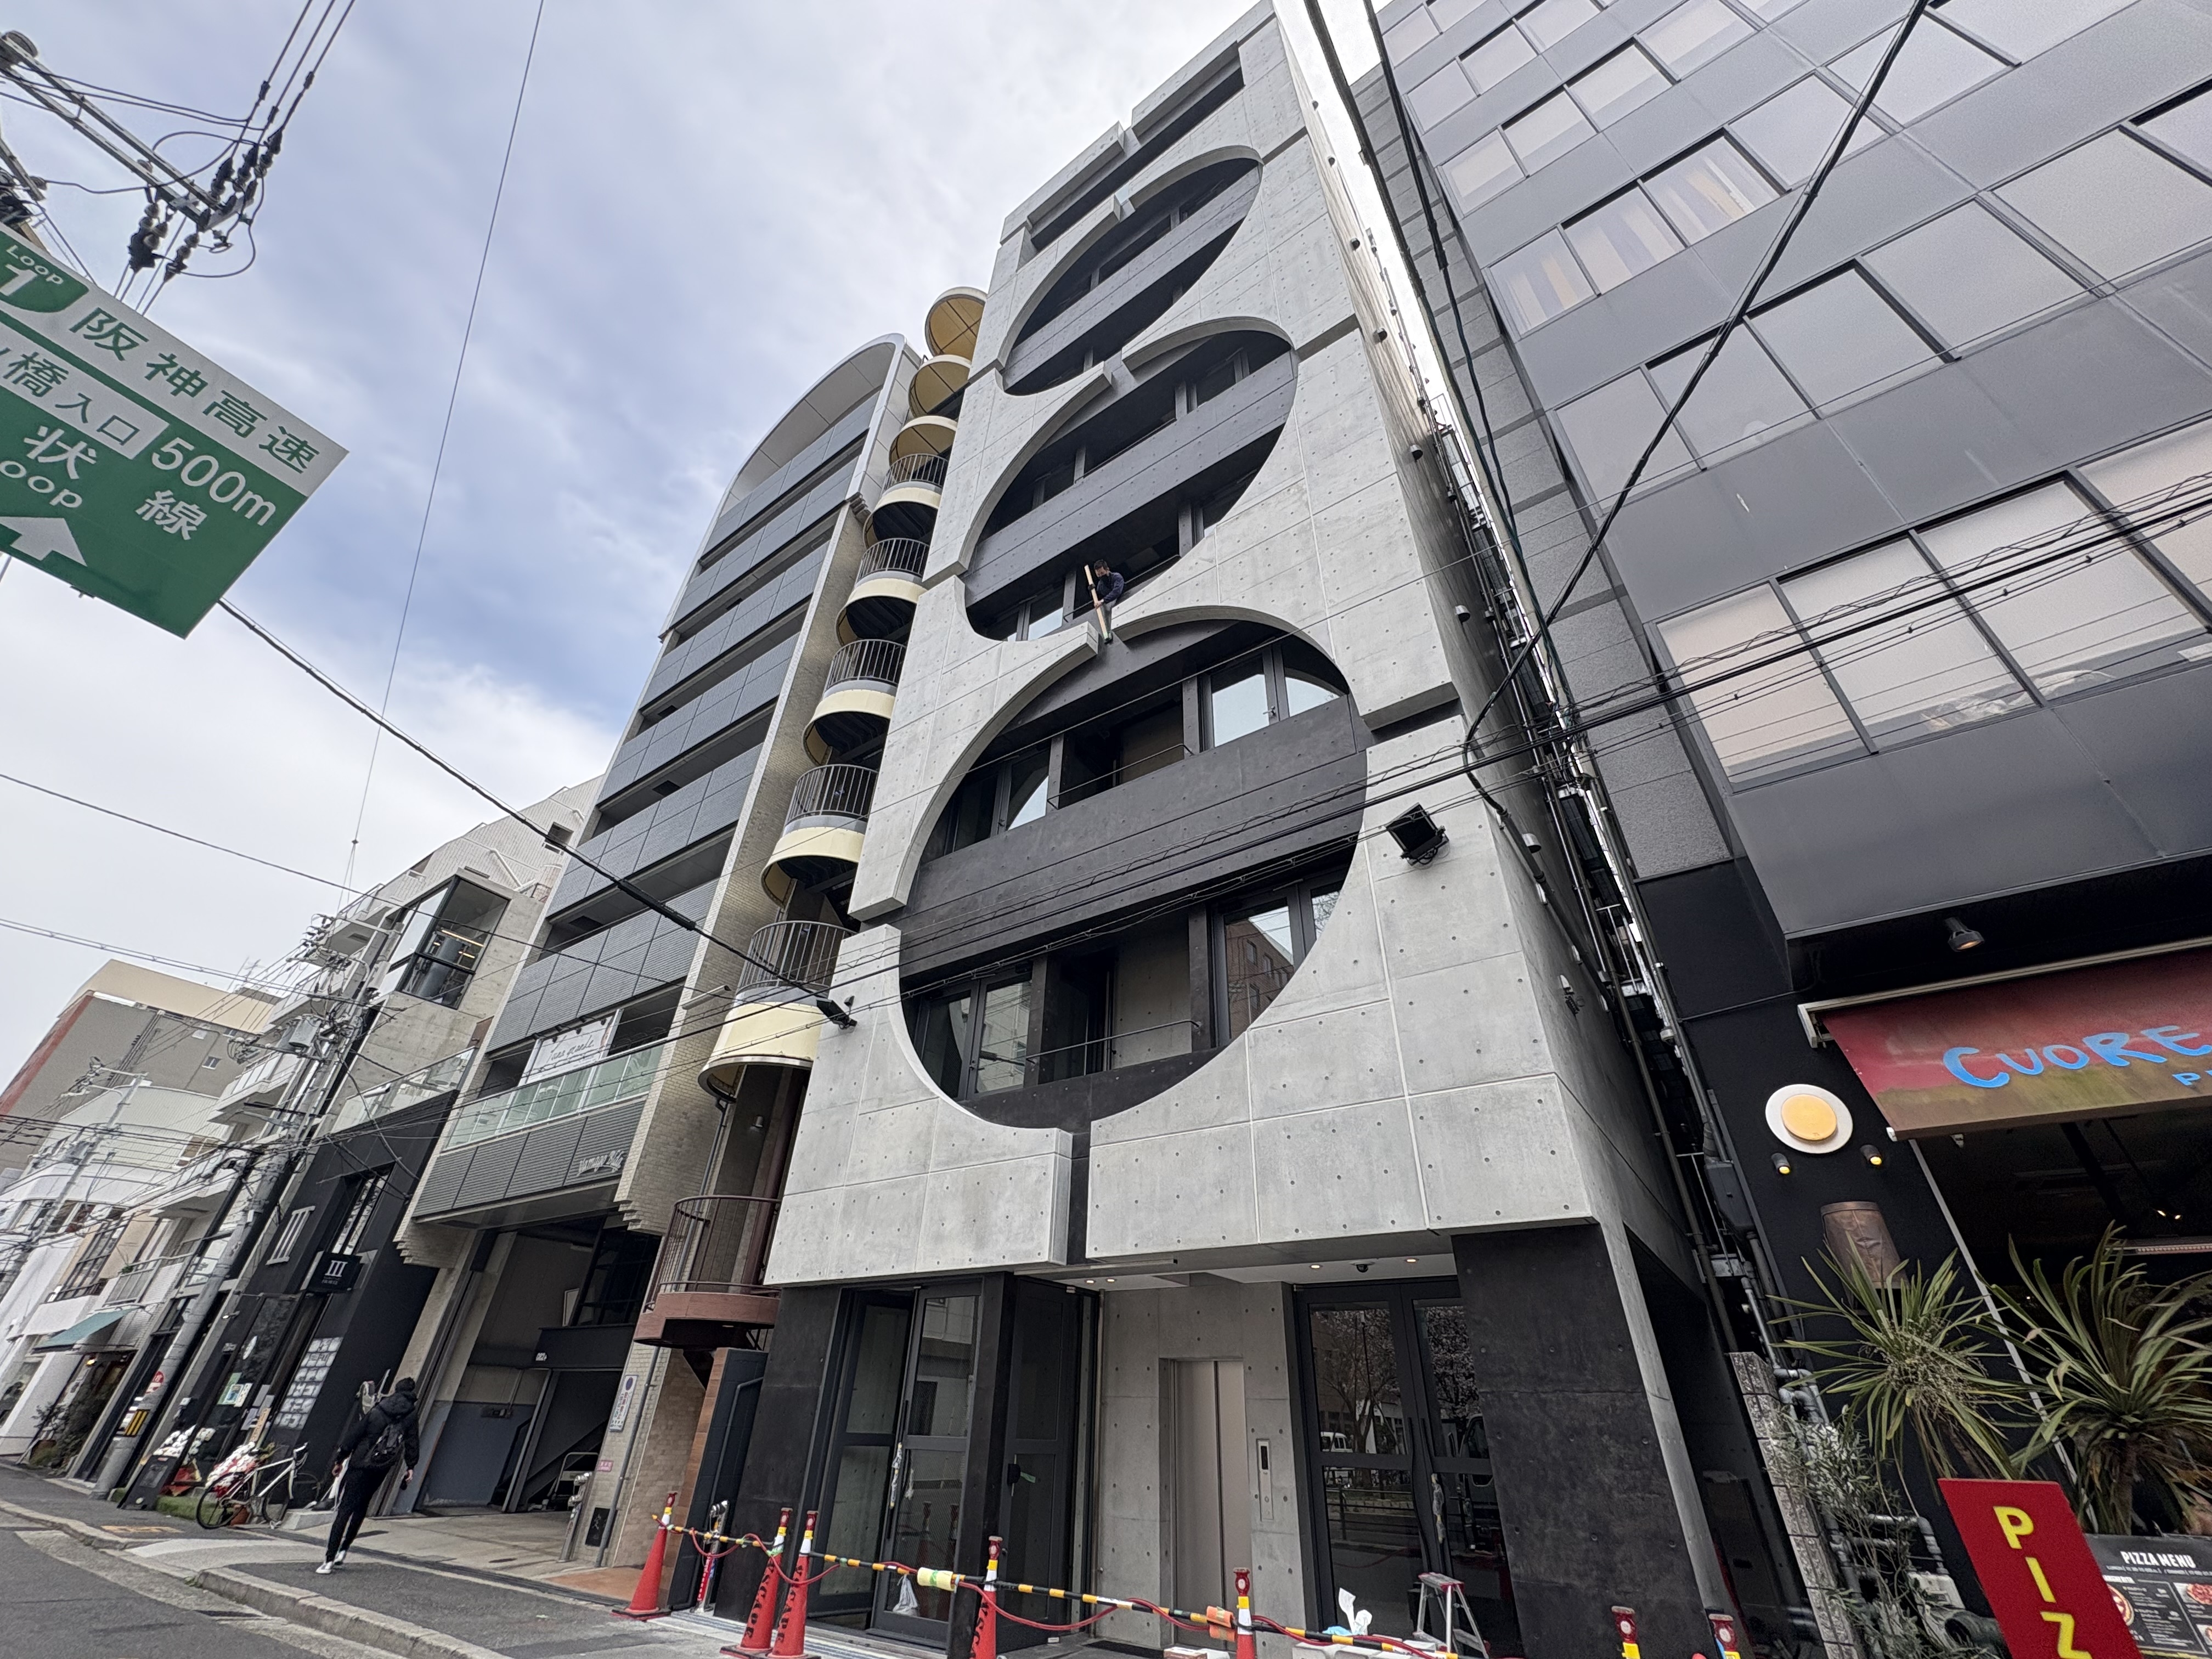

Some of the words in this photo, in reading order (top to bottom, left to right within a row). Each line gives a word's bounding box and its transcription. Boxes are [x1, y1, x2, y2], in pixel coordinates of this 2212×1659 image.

[0, 347, 140, 446] 橋入口
[69, 307, 320, 474] 阪神高速
[151, 437, 276, 527] 500m
[1943, 1025, 2212, 1088] CUORE
[2120, 1551, 2160, 1566] PIZZA
[2156, 1553, 2197, 1568] MENU
